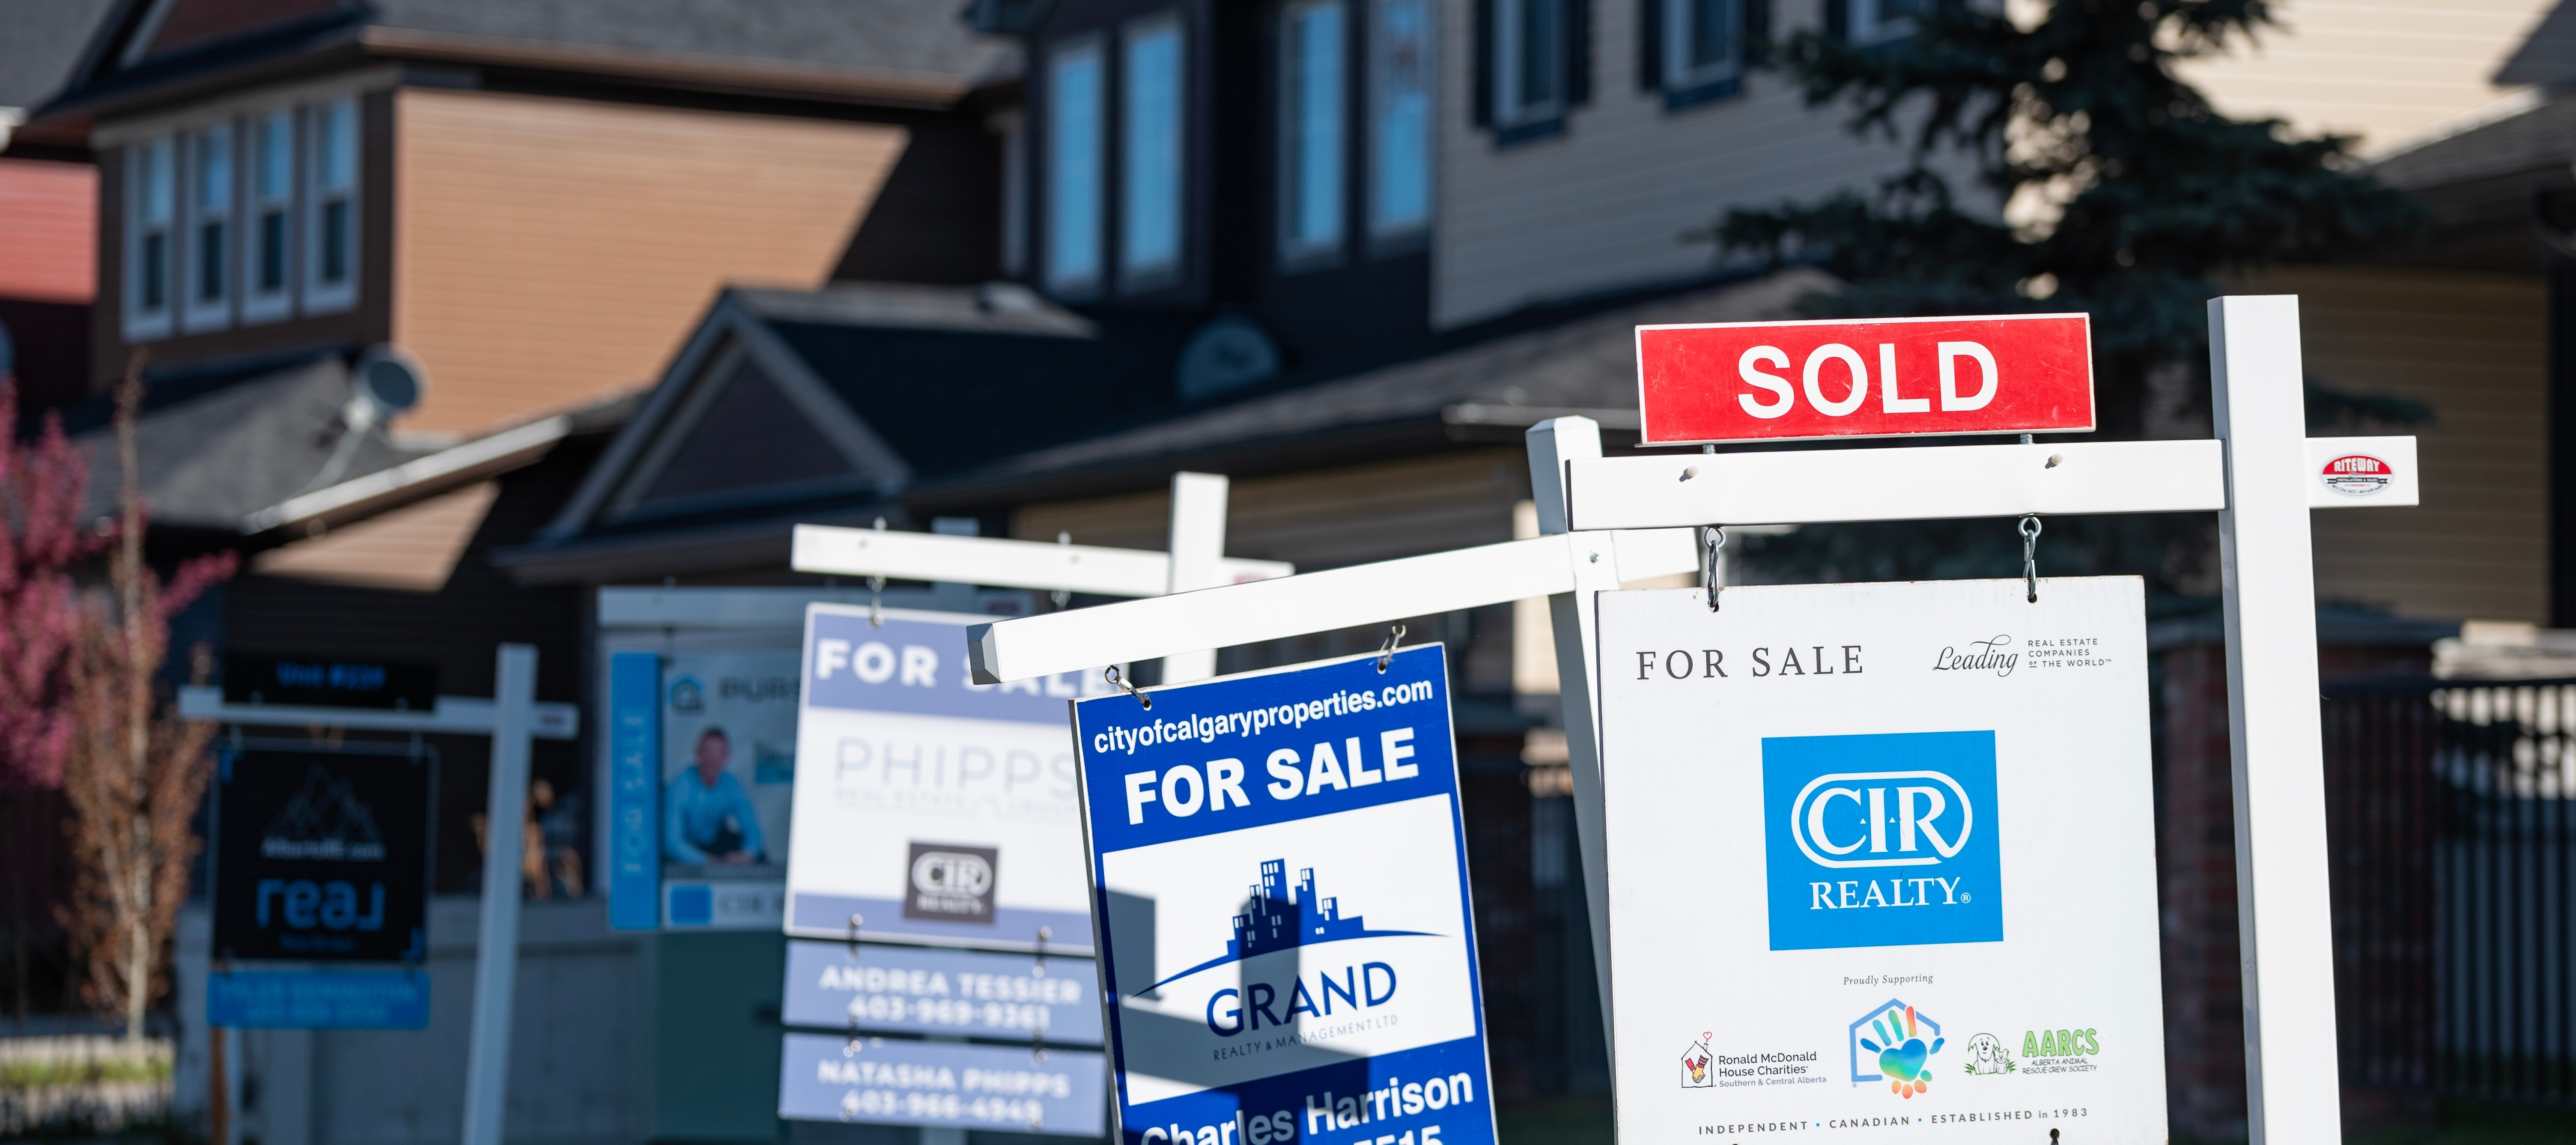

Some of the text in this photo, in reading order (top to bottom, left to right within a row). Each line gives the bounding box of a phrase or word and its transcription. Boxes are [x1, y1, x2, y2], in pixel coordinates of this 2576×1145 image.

[1737, 341, 1999, 419] SOLD
[2334, 458, 2380, 472] RITEWAY
[816, 638, 939, 687] FOR
[1636, 645, 1863, 680] FOR SALE
[1932, 635, 2018, 677] Leading
[1094, 680, 1432, 755] cityofcalgaryproperties.com
[835, 736, 1077, 802] PHIPPS
[1124, 727, 1419, 826] FOR SALE
[1807, 785, 1953, 858] CIR
[920, 856, 987, 894] CIR
[818, 965, 1082, 1005] ANDREA TESSIER
[1207, 961, 1396, 1037] GRAND
[1843, 974, 1934, 987] Proudly Supporting
[1213, 1014, 1398, 1061] REALTY & MANAGEMENT LTD
[2022, 1028, 2099, 1057] AARCS
[1719, 1051, 1817, 1065] Ronald McDonald
[1719, 1067, 1754, 1077] House
[817, 1059, 1071, 1099] NATASHA PHIPPS
[1719, 1079, 1756, 1087] Southern
[1306, 1072, 1473, 1135] Harrison
[1699, 1108, 2088, 1135] INDEPENDENT CANADIAN ESTABLISHED in 1983
